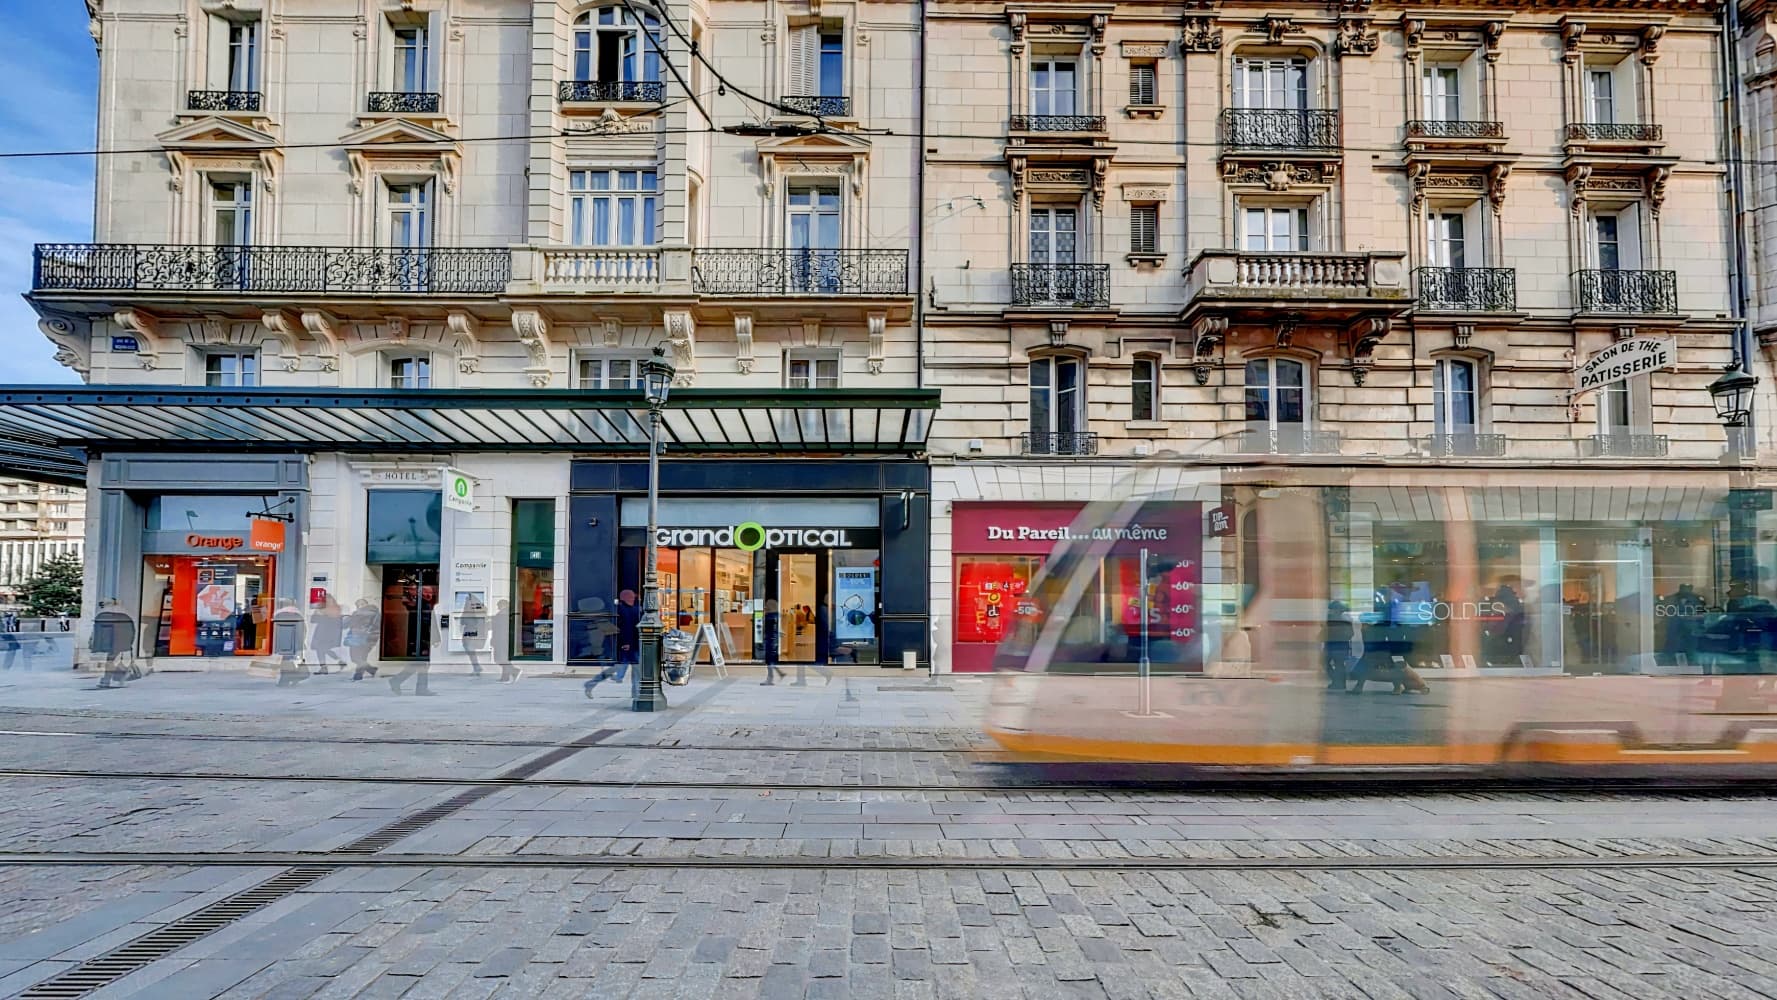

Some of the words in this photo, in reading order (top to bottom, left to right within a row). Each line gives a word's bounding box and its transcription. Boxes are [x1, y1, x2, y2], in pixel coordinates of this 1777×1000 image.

[1585, 347, 1618, 373] SALON
[1621, 342, 1634, 352] DE
[1581, 351, 1667, 388] PATISSERIE
[988, 526, 1014, 540] Du
[1092, 527, 1112, 540] au
[1115, 524, 1168, 541] même
[186, 534, 243, 550] Orange
[255, 540, 281, 549] orange
[1418, 602, 1506, 621] SOLDES
